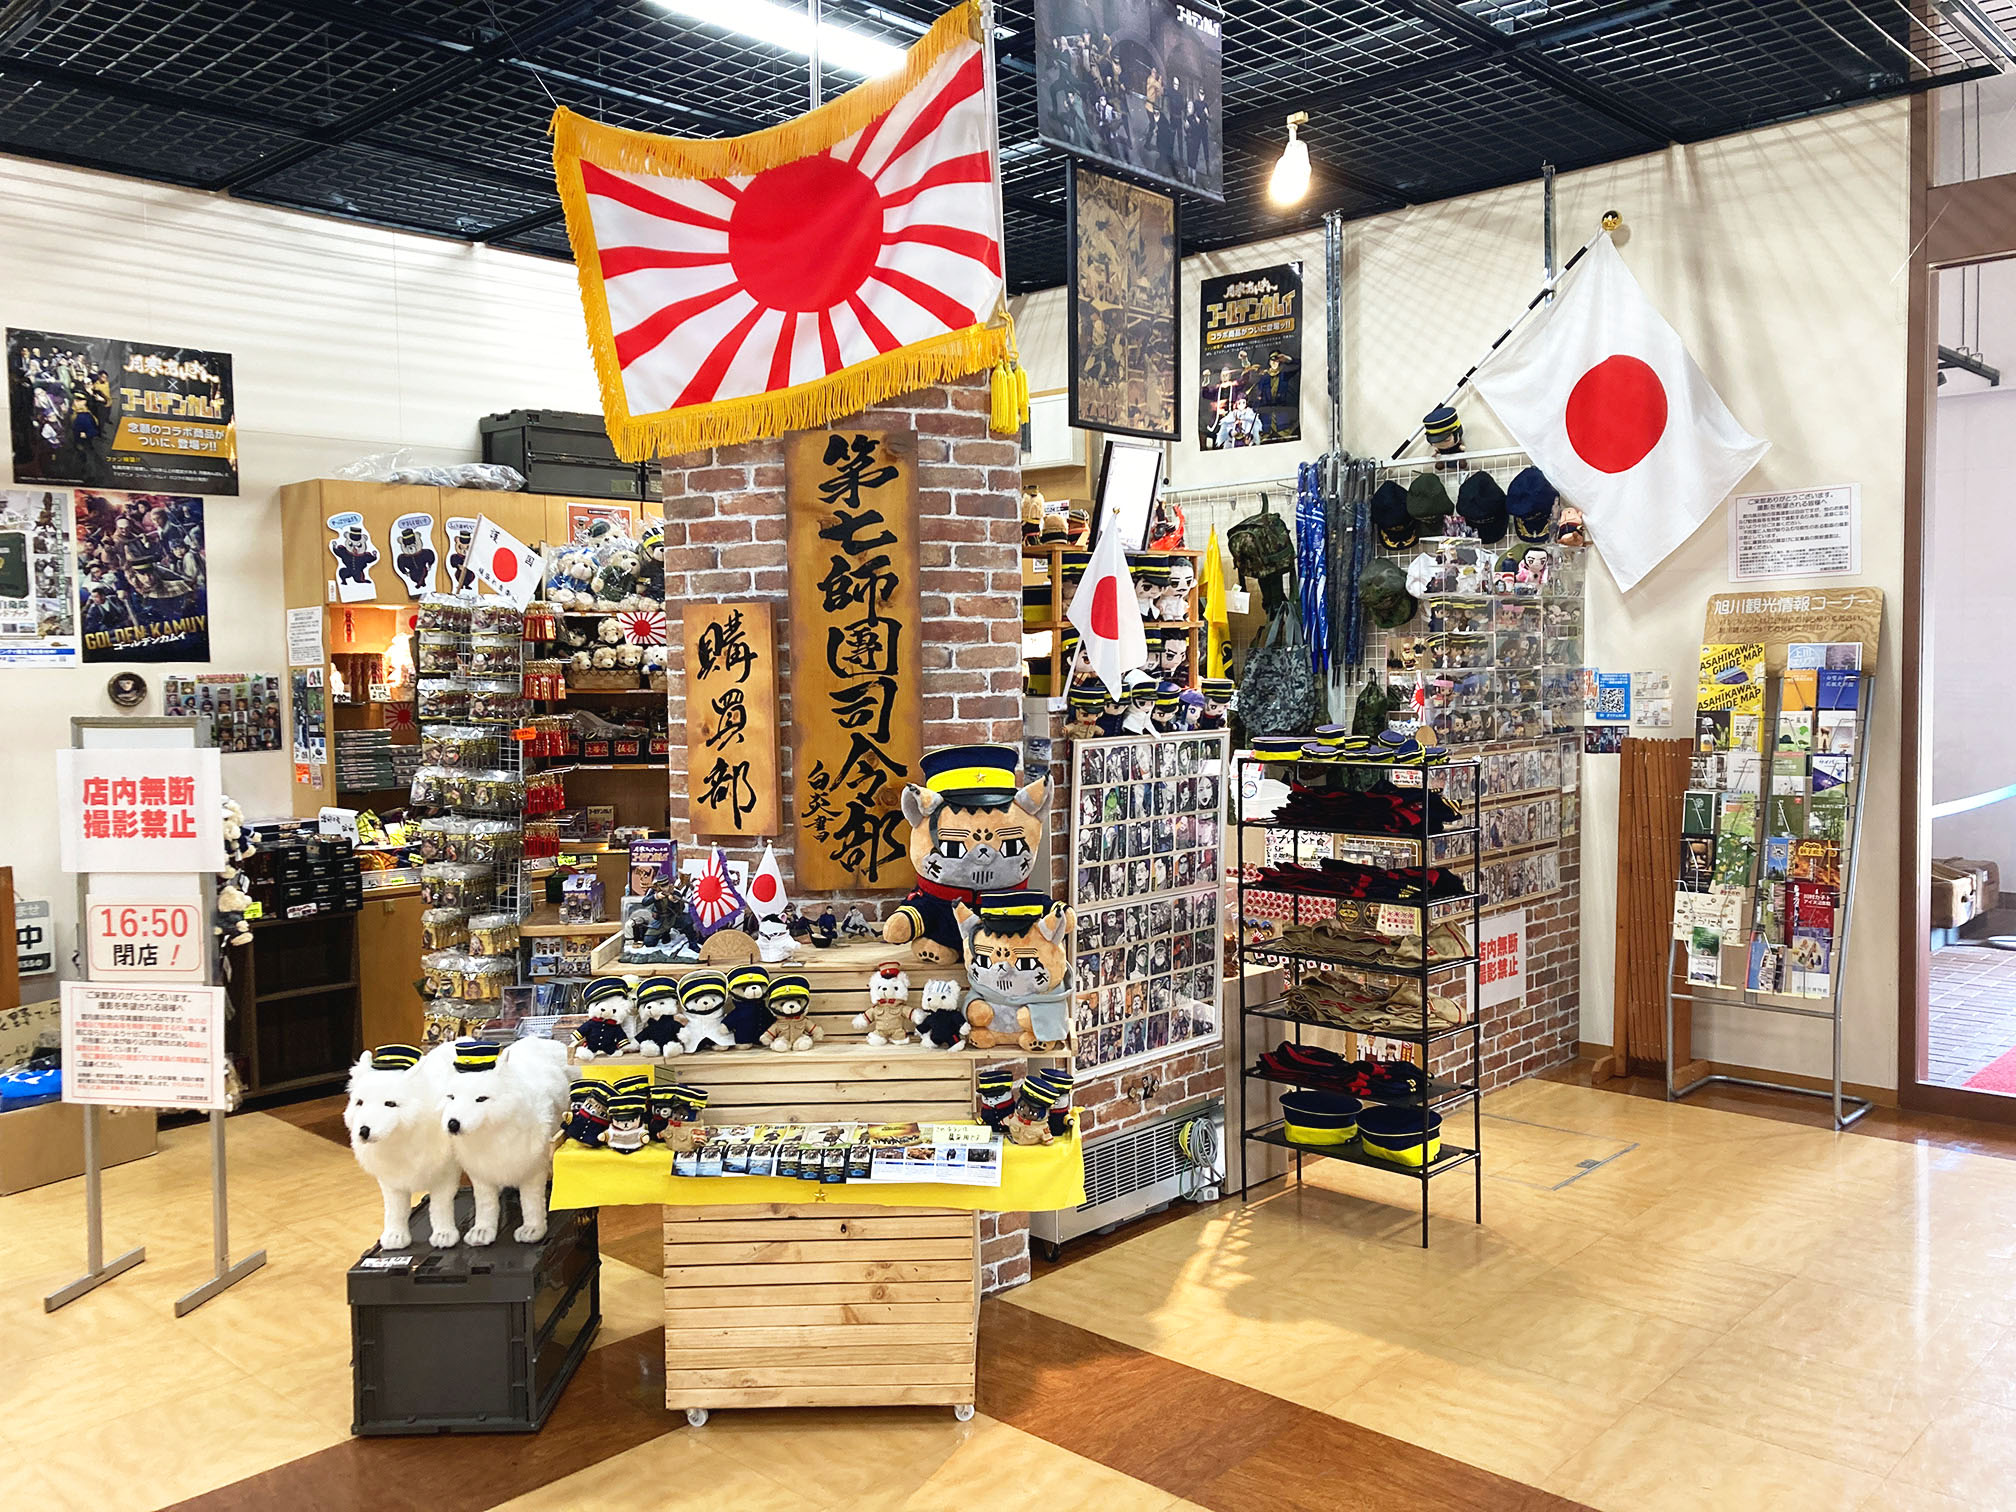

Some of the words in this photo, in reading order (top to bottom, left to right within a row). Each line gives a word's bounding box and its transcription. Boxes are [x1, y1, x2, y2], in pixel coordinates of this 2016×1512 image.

[1206, 290, 1296, 329] ゴールデンカムイ
[120, 387, 224, 419] ゴールデンカムイ
[1713, 593, 1874, 616] 旭川観光情報コーナー
[84, 625, 146, 651] GOLDEN
[149, 615, 206, 639] KAMUY
[113, 631, 187, 651] ゴールデンカムイ
[817, 433, 908, 883] 第七師團司令部
[1700, 642, 1755, 672] ASAHIKAWA
[1712, 658, 1743, 675] GUIDE
[1743, 647, 1764, 664] MAP
[1697, 683, 1753, 711] ASAHIKAWA
[1740, 689, 1762, 705] MAP
[696, 609, 758, 830] 購買部
[82, 776, 195, 807] 店内無断
[84, 809, 197, 840] 撮影禁止
[1276, 835, 1315, 844] プレント
[101, 908, 188, 938] 16:50
